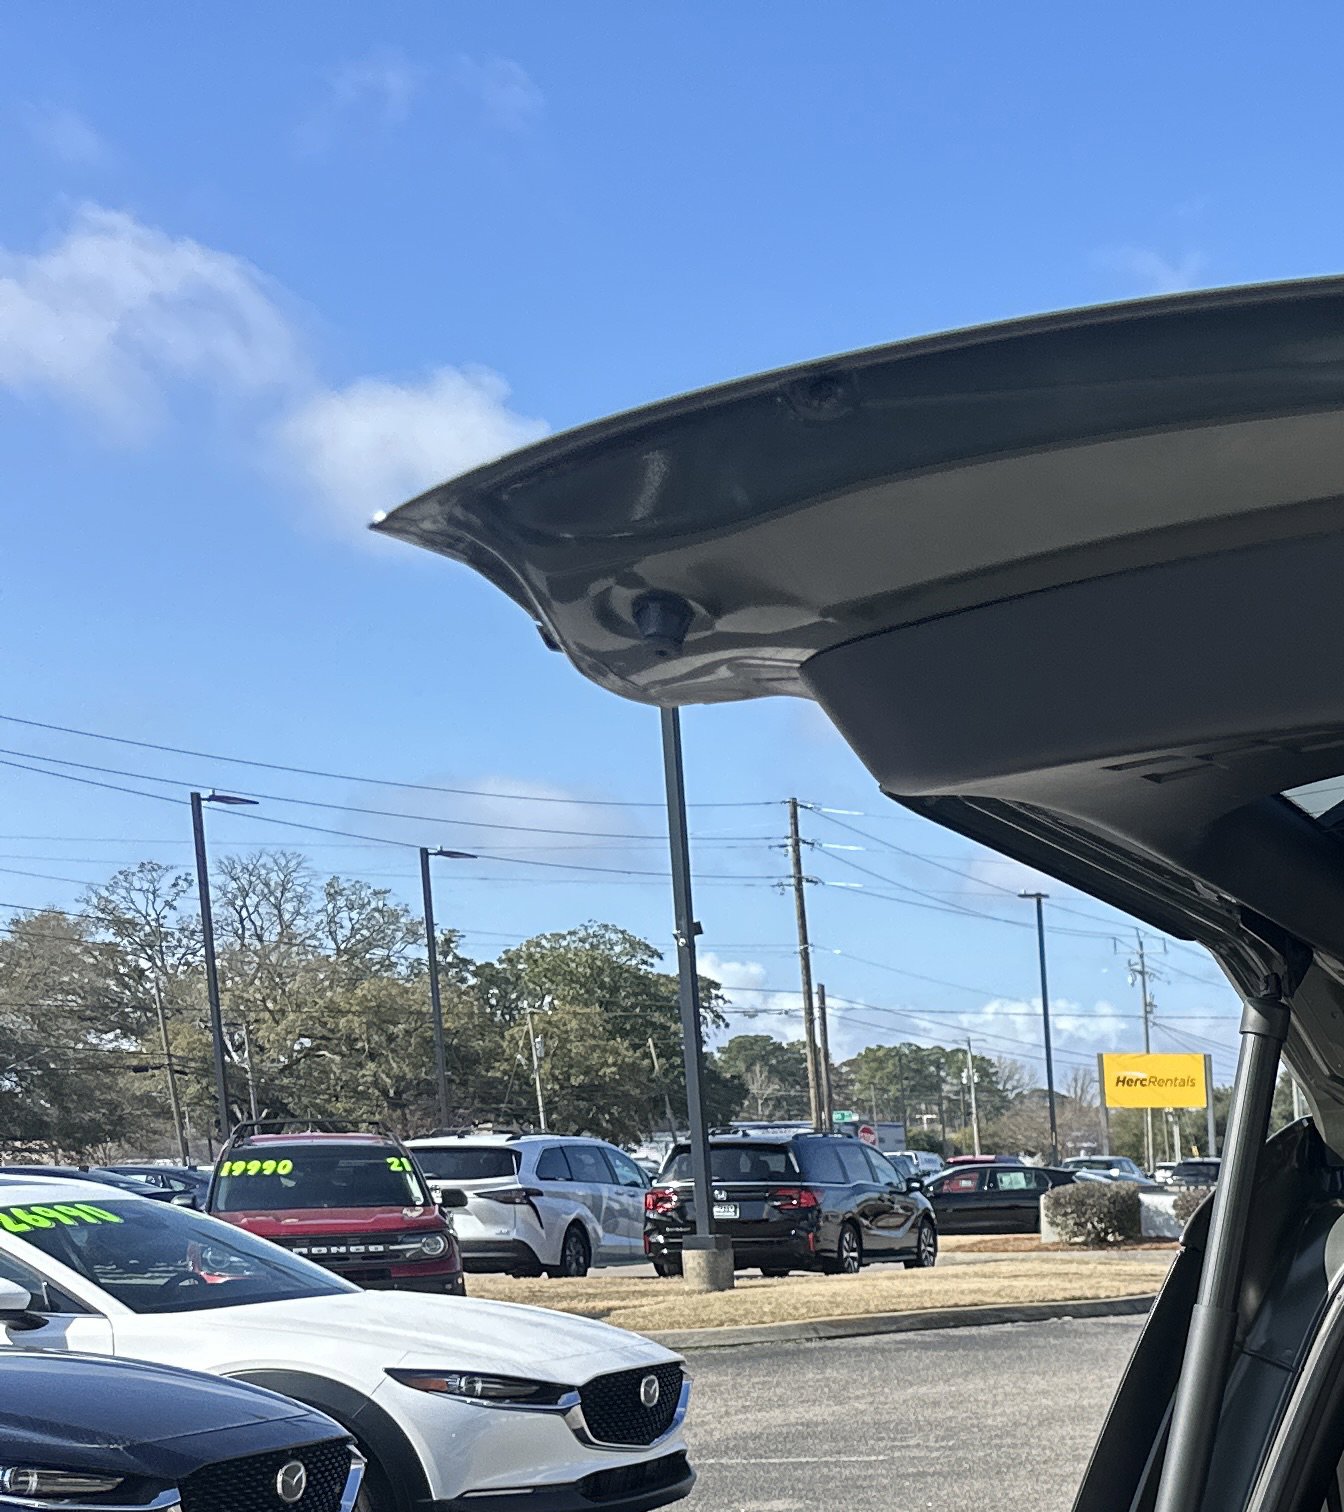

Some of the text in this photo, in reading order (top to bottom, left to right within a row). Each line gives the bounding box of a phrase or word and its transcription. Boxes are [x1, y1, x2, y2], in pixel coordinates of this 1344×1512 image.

[220, 1156, 412, 1177] 19990 21
[0, 1203, 124, 1233] 26990
